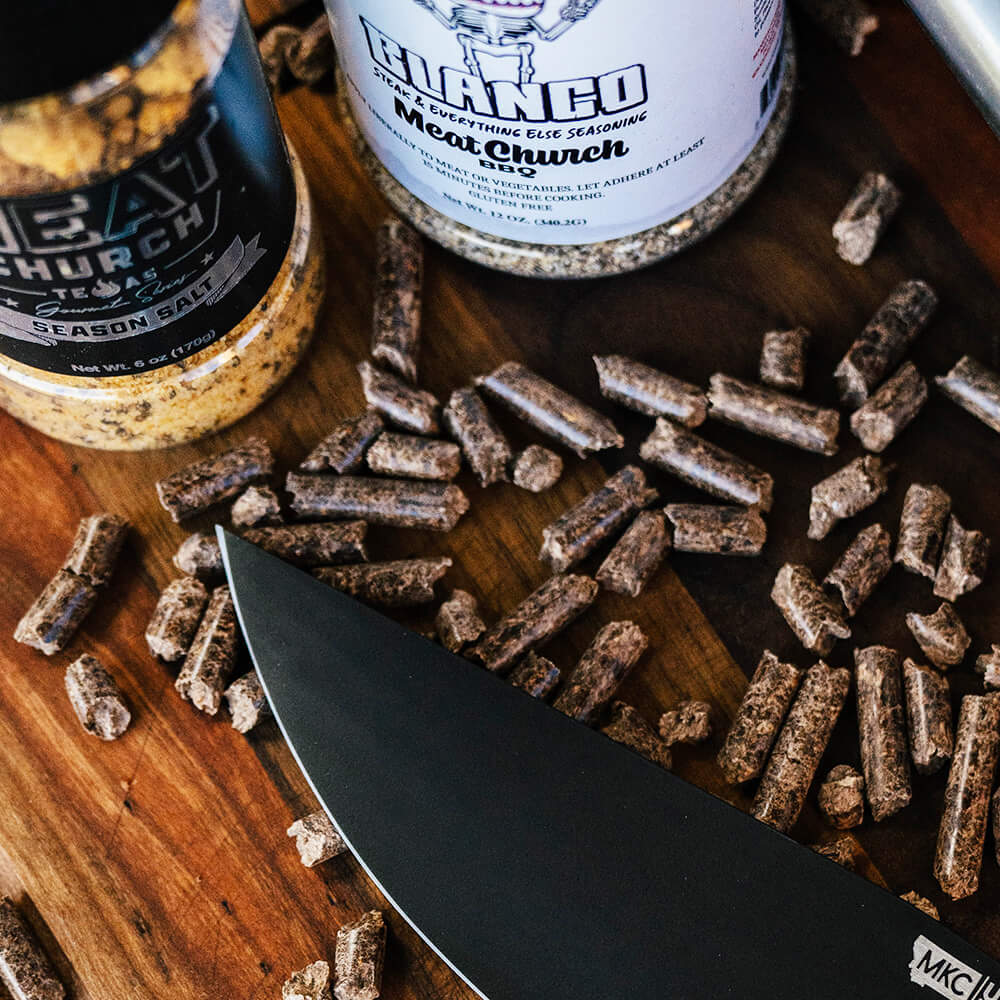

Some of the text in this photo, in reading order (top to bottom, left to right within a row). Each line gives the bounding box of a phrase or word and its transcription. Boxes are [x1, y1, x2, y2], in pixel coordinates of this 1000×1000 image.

[358, 13, 649, 124] BLANCO
[373, 66, 411, 99] STEAK
[414, 94, 426, 109] &
[429, 103, 521, 138] EVERYTHING
[526, 128, 562, 140] ELSE
[566, 110, 648, 140] SEASONING
[394, 95, 630, 166] Meat Church
[436, 158, 470, 177] MEAT
[472, 172, 489, 185] OR
[577, 181, 601, 192] LET
[603, 166, 654, 188] ADHERE
[656, 158, 672, 172] AT
[673, 136, 706, 163] LEAST
[436, 167, 491, 194] MINUTES
[494, 188, 542, 202] BEFORE
[479, 159, 538, 179] BBQ
[468, 189, 553, 212] GLUTEN FREE
[32, 276, 214, 338] SEASON SALT
[51, 268, 158, 300] TEAS
[71, 363, 101, 374] Net
[134, 359, 145, 368] 6
[149, 354, 169, 366] oz
[171, 329, 217, 359] (170g)
[916, 949, 973, 996] MKC
